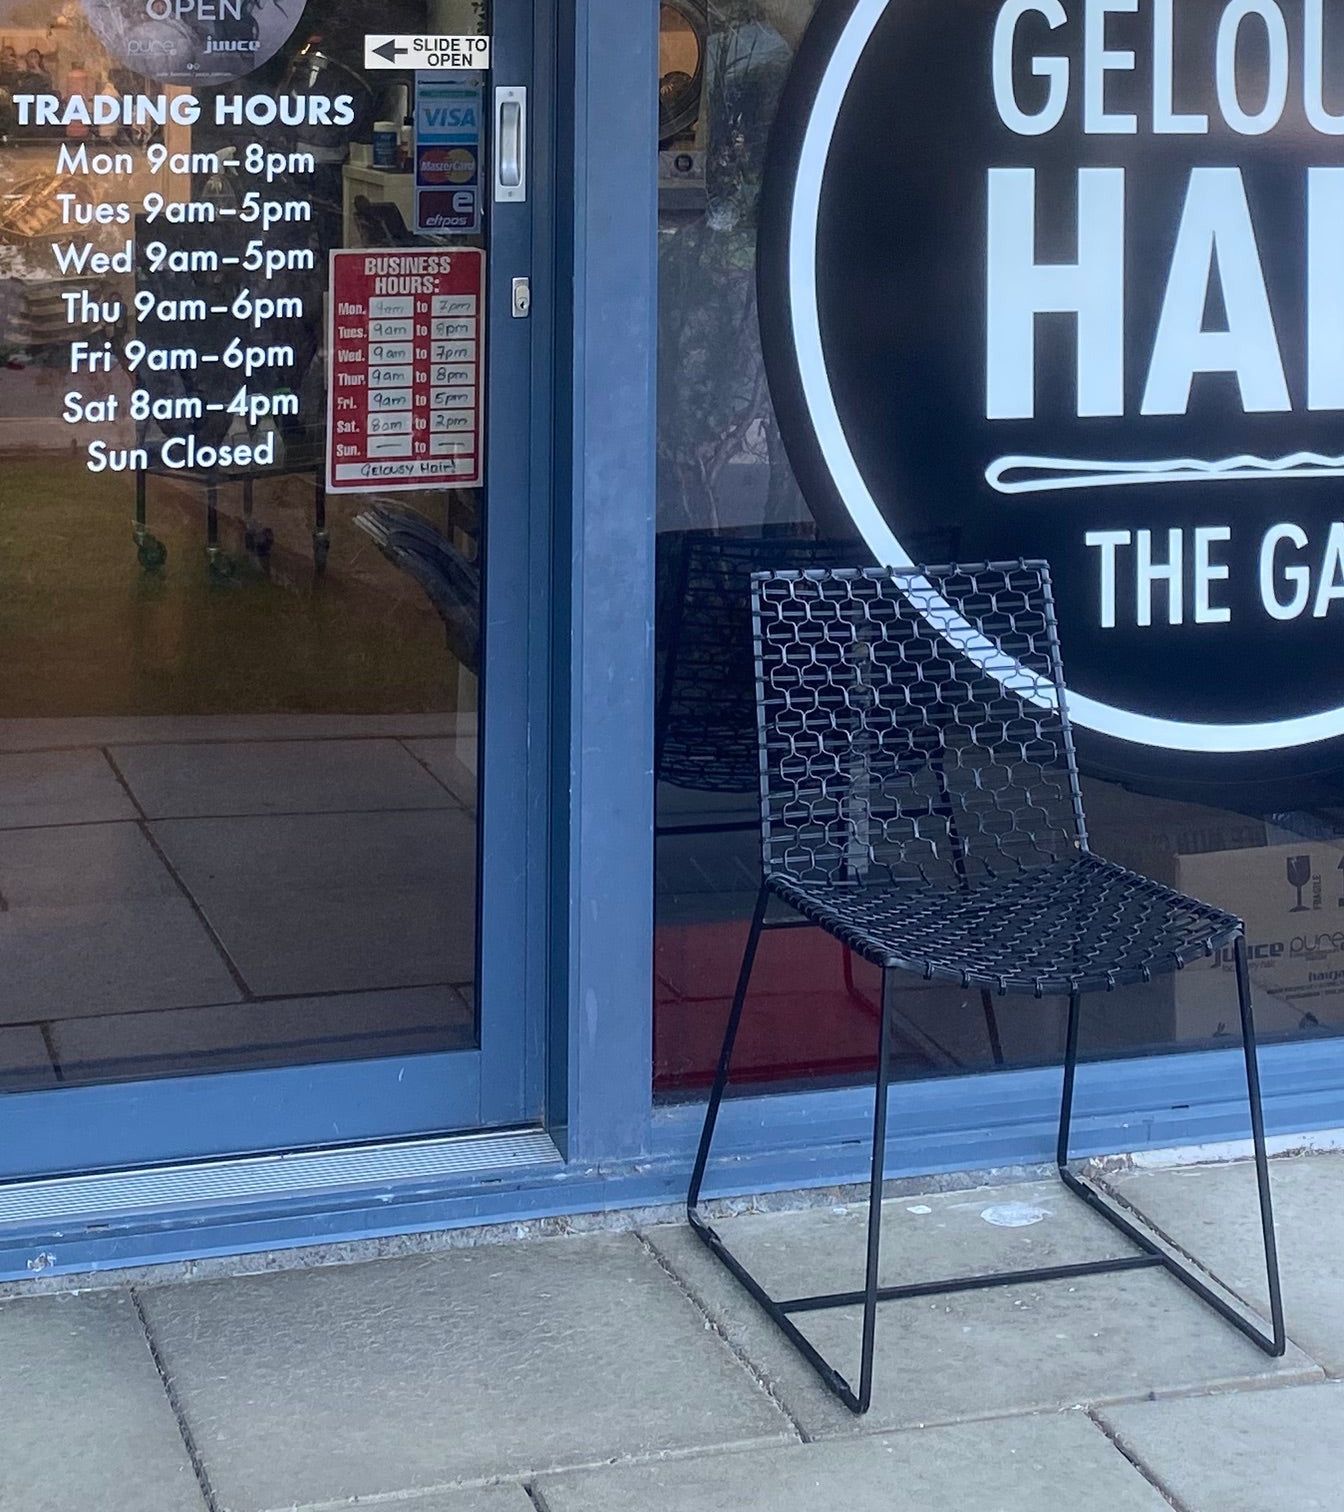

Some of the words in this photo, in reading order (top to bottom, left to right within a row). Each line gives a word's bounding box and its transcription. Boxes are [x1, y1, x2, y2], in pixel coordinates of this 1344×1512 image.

[413, 39, 460, 53] SLIDE
[465, 38, 487, 52] TO
[427, 53, 473, 67] OPEN
[12, 95, 201, 126] TRADING
[215, 94, 355, 126] HOURS
[424, 108, 476, 127] VISA
[56, 145, 134, 175] Mon
[57, 195, 130, 224] Tues
[425, 213, 467, 228] eftpos
[51, 241, 134, 275] Wed
[364, 256, 451, 276] BUSINESS
[375, 276, 440, 294] HOURS:
[62, 291, 121, 324] Thu
[338, 301, 366, 316] Mon.
[416, 300, 428, 313] to
[338, 327, 366, 340] Tues.
[373, 323, 407, 337] 9am
[416, 324, 428, 336] to
[70, 342, 111, 373] Fri
[338, 349, 365, 363] Wed.
[373, 346, 406, 359] 9am
[416, 347, 428, 360] to
[338, 373, 366, 386] Thur.
[371, 369, 406, 383] 9am
[415, 370, 427, 383] to
[436, 367, 468, 382] 8pm
[62, 391, 118, 423] Sat
[373, 394, 406, 408] 9am
[415, 394, 427, 407] to
[434, 392, 469, 407] 5pm
[337, 420, 360, 433] Sat.
[371, 418, 403, 432] 8am
[415, 417, 427, 430] to
[87, 440, 148, 473] Sun
[161, 433, 274, 467] Closed
[337, 444, 361, 457] Sun.
[415, 441, 427, 454] to
[1085, 525, 1231, 628] THE
[1290, 931, 1344, 958] pure
